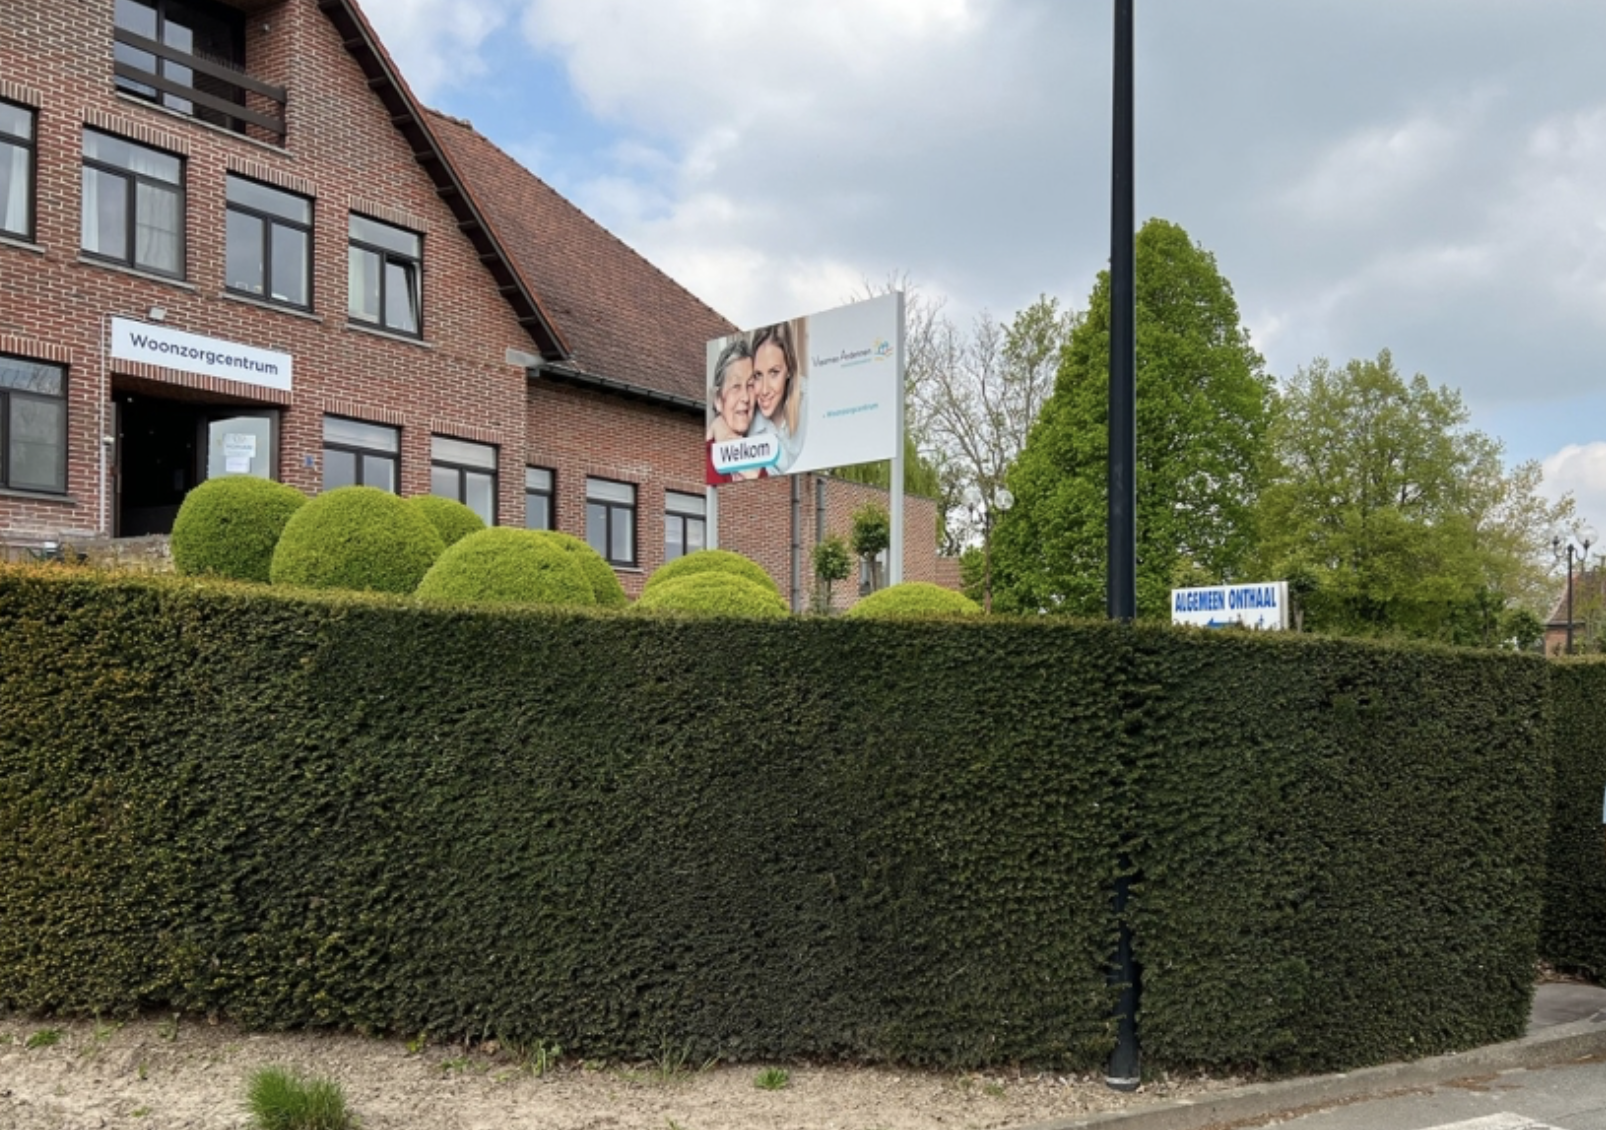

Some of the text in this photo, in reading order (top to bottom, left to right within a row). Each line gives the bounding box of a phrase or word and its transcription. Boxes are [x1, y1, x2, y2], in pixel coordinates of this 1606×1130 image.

[129, 332, 279, 375] Woonzorgcentrum
[720, 442, 771, 462] Welkom
[1175, 586, 1276, 612] ALGEMEEN ONTHAAL
